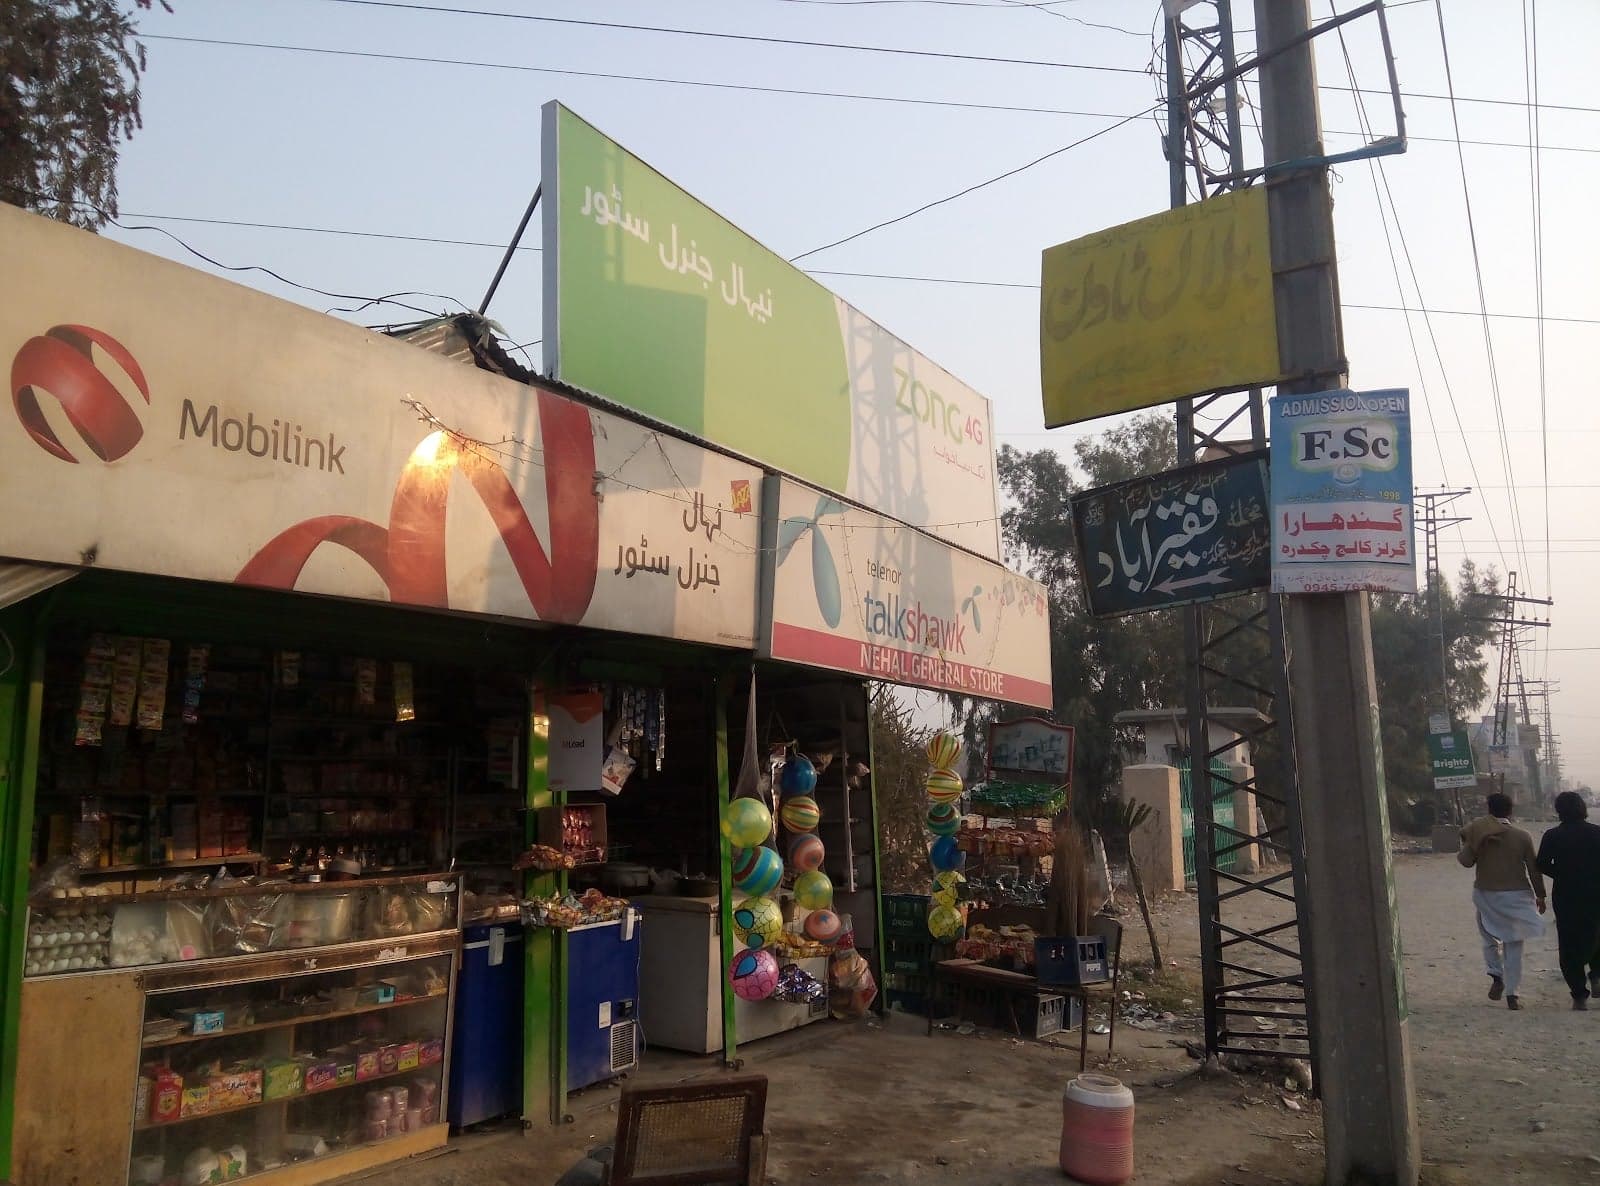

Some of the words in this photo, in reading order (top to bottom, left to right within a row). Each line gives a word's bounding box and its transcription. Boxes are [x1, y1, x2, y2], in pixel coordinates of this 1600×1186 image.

[580, 183, 649, 243] سٹور
[659, 223, 713, 289] جنرل
[1280, 394, 1365, 417] ADMISSION
[1367, 396, 1406, 412] OPEN
[178, 398, 347, 475] Mobilink
[965, 415, 983, 445] 4G
[1300, 427, 1390, 461] F.Sc
[682, 491, 722, 542] نہال
[1283, 508, 1403, 537] گندھارا
[614, 534, 670, 578] سٹور
[1281, 541, 1331, 560] چکدرہ
[1335, 540, 1371, 558] کالج
[1374, 540, 1407, 558] گرلز
[677, 547, 721, 593] جنرل
[866, 558, 902, 585] telenor
[864, 591, 966, 655] talkshawk
[860, 643, 908, 677] NEHAL
[912, 656, 967, 689] GENERAL
[969, 669, 1004, 694] STORE
